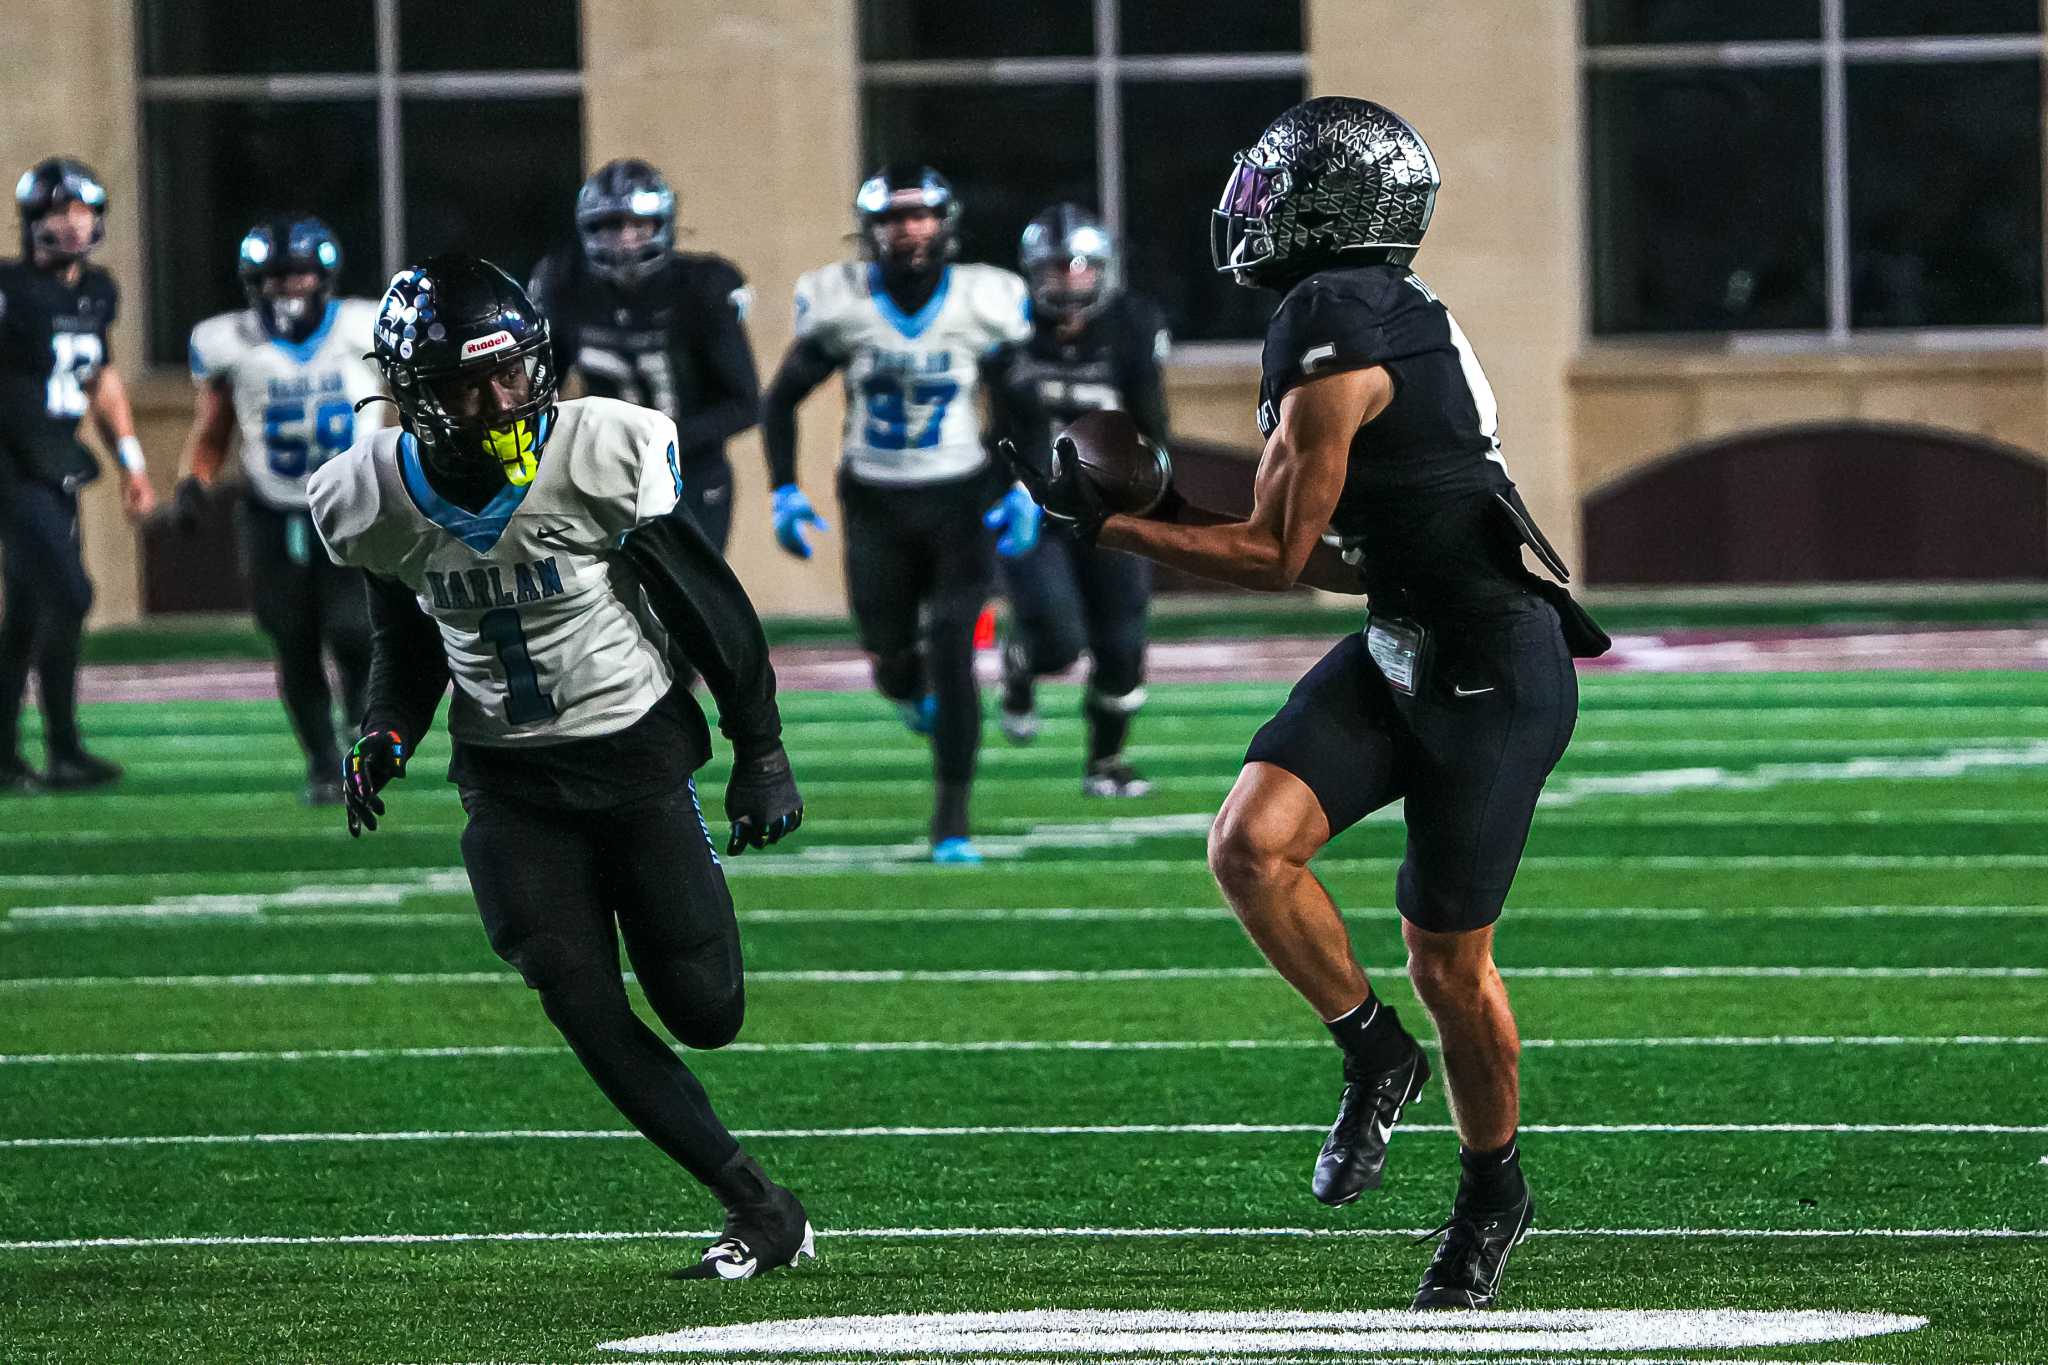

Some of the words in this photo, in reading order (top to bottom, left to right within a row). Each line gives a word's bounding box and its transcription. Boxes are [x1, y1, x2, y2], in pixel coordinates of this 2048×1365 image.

[466, 333, 508, 353] Riddell
[265, 401, 354, 478] 59
[862, 375, 960, 451] 97
[425, 556, 565, 609] HARLAN
[478, 607, 557, 726] 1
